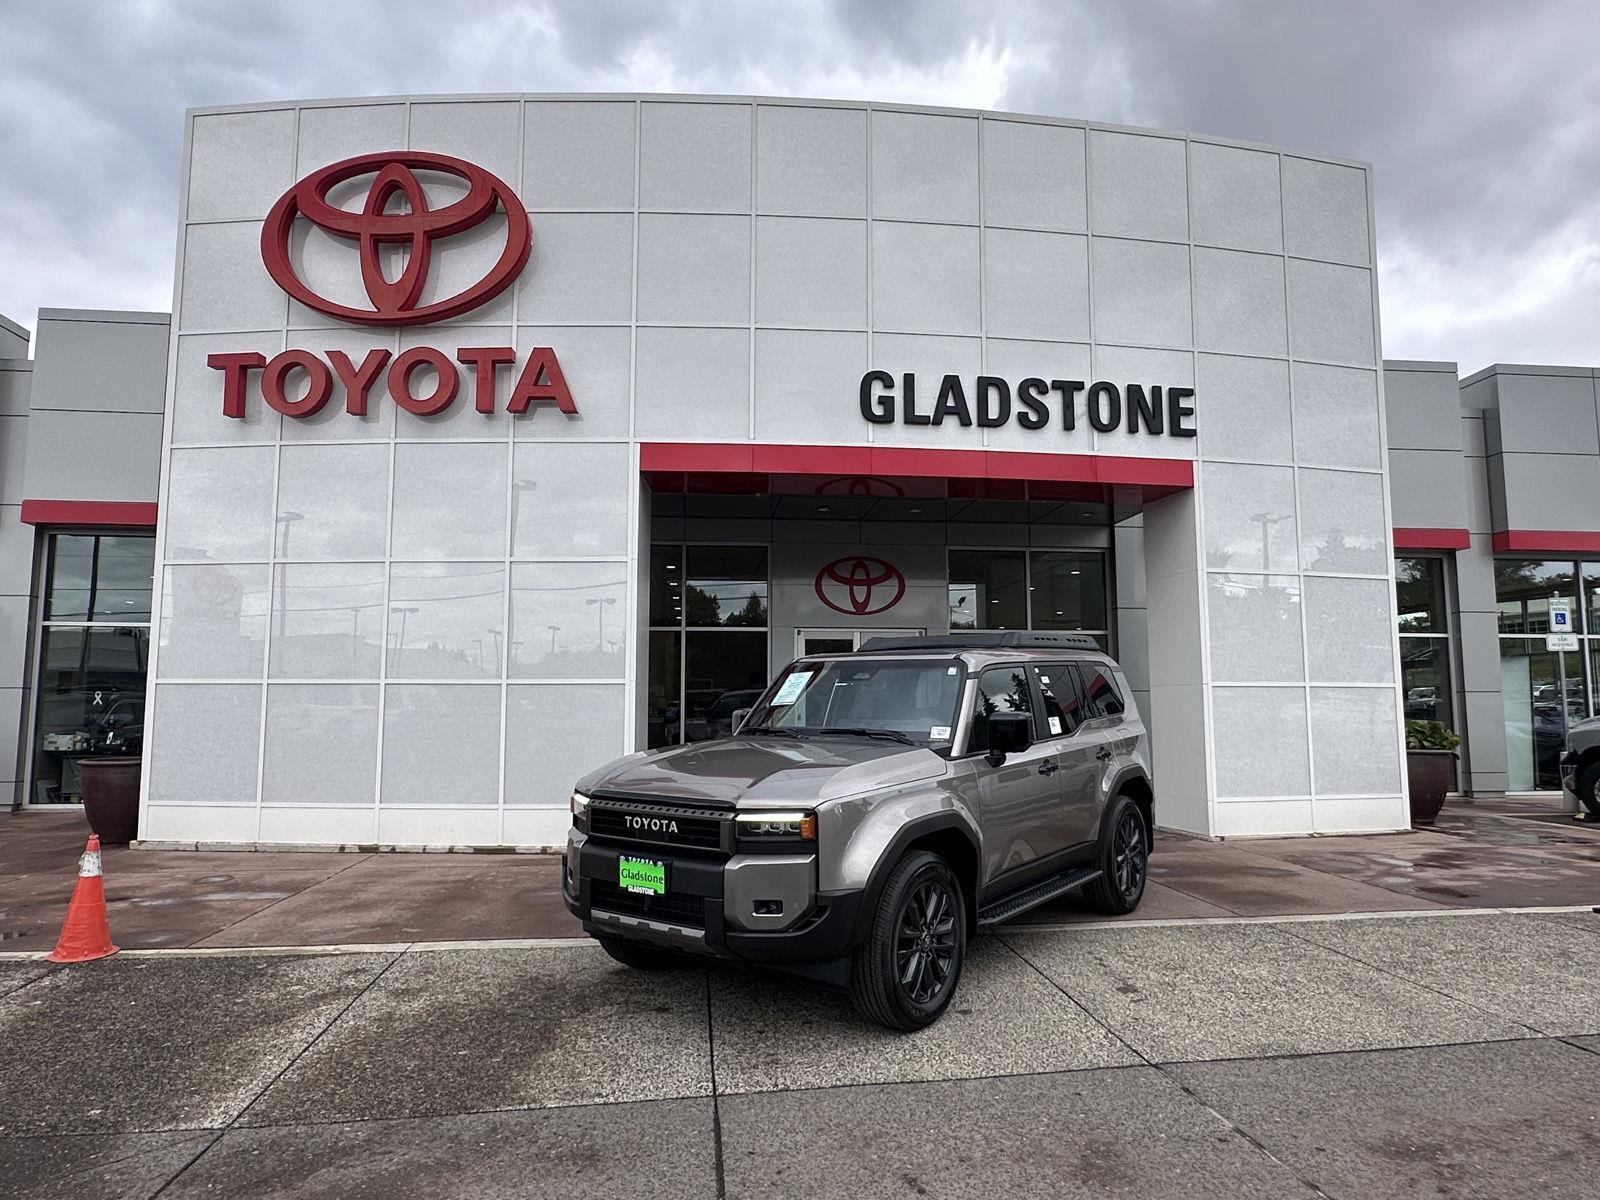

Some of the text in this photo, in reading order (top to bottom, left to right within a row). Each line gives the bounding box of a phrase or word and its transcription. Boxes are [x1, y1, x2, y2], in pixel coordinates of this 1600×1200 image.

[207, 346, 579, 418] TOYOTA
[859, 369, 1197, 438] GLADSTONE
[625, 816, 678, 833] TOYOTA
[621, 868, 664, 884] Gladstone
